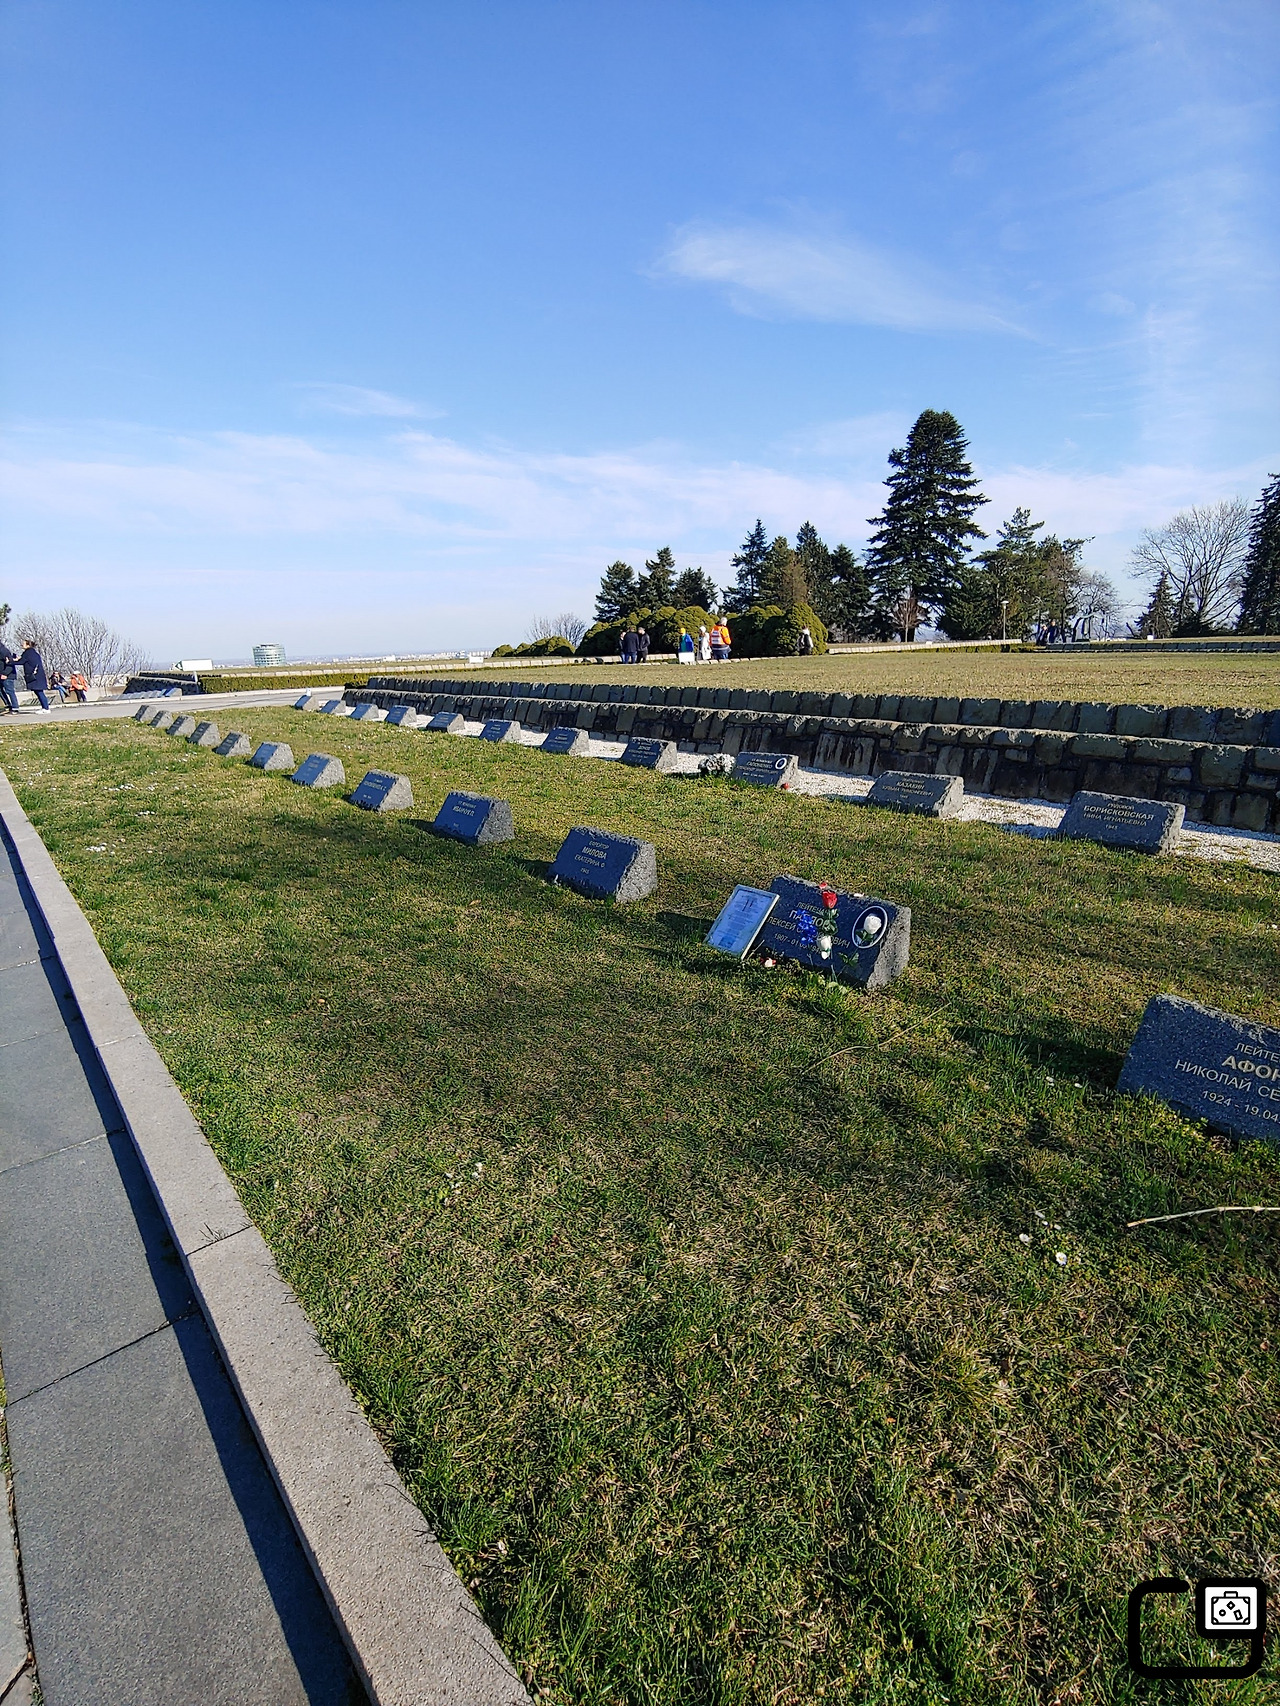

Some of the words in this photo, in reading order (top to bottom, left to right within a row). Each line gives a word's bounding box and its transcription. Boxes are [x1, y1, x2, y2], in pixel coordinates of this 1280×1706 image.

[1083, 805, 1154, 820] БОРИСКОВСКАЯ
[1103, 815, 1147, 827] ИГНАТЬЕВНА
[582, 846, 607, 859] МИЛОВА
[574, 854, 600, 867] ЕКАТЕРИНА
[767, 916, 797, 931] ЛЕКСЕЙ
[1175, 1059, 1252, 1092] НИКОЛАЙ
[1203, 1090, 1231, 1107] 1924
